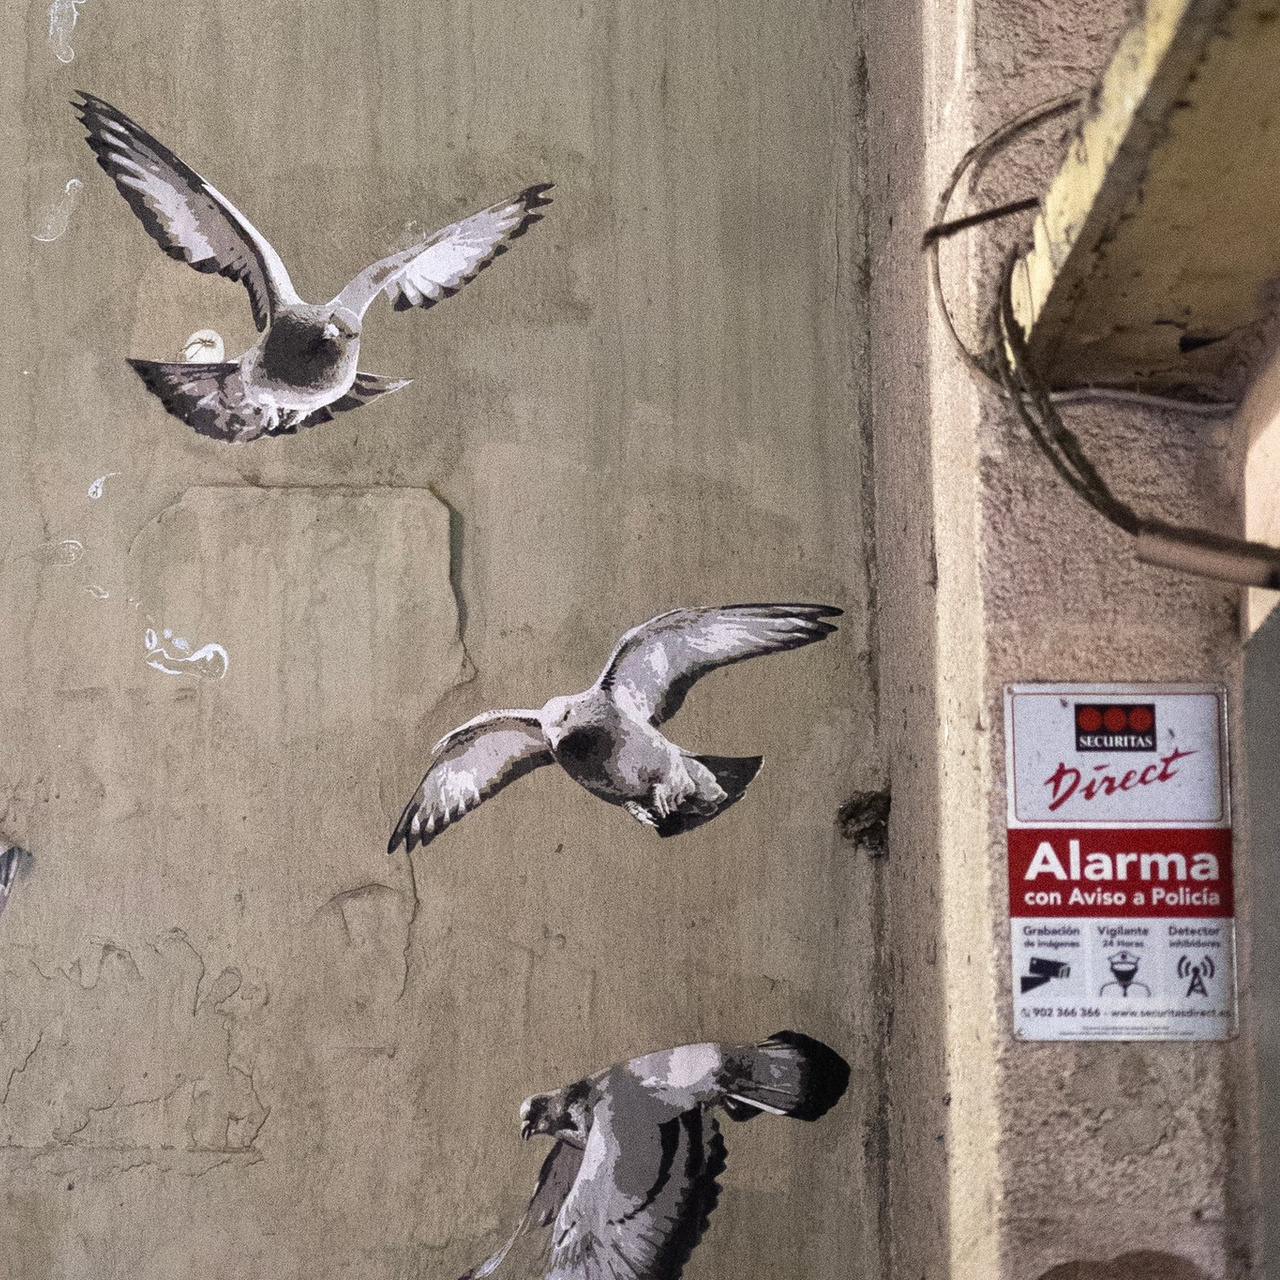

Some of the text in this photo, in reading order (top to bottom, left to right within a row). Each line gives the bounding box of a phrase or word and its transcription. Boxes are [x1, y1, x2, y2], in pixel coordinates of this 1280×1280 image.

[1079, 735, 1153, 748] SECURITAS
[1044, 748, 1197, 812] Direct
[1024, 839, 1219, 881] Alarma
[1024, 887, 1220, 906] con Aviso a Policía
[1023, 925, 1080, 936] Grabación
[1097, 926, 1149, 938] Vigilante
[1168, 926, 1220, 936] Detector
[1033, 1008, 1053, 1017] 902
